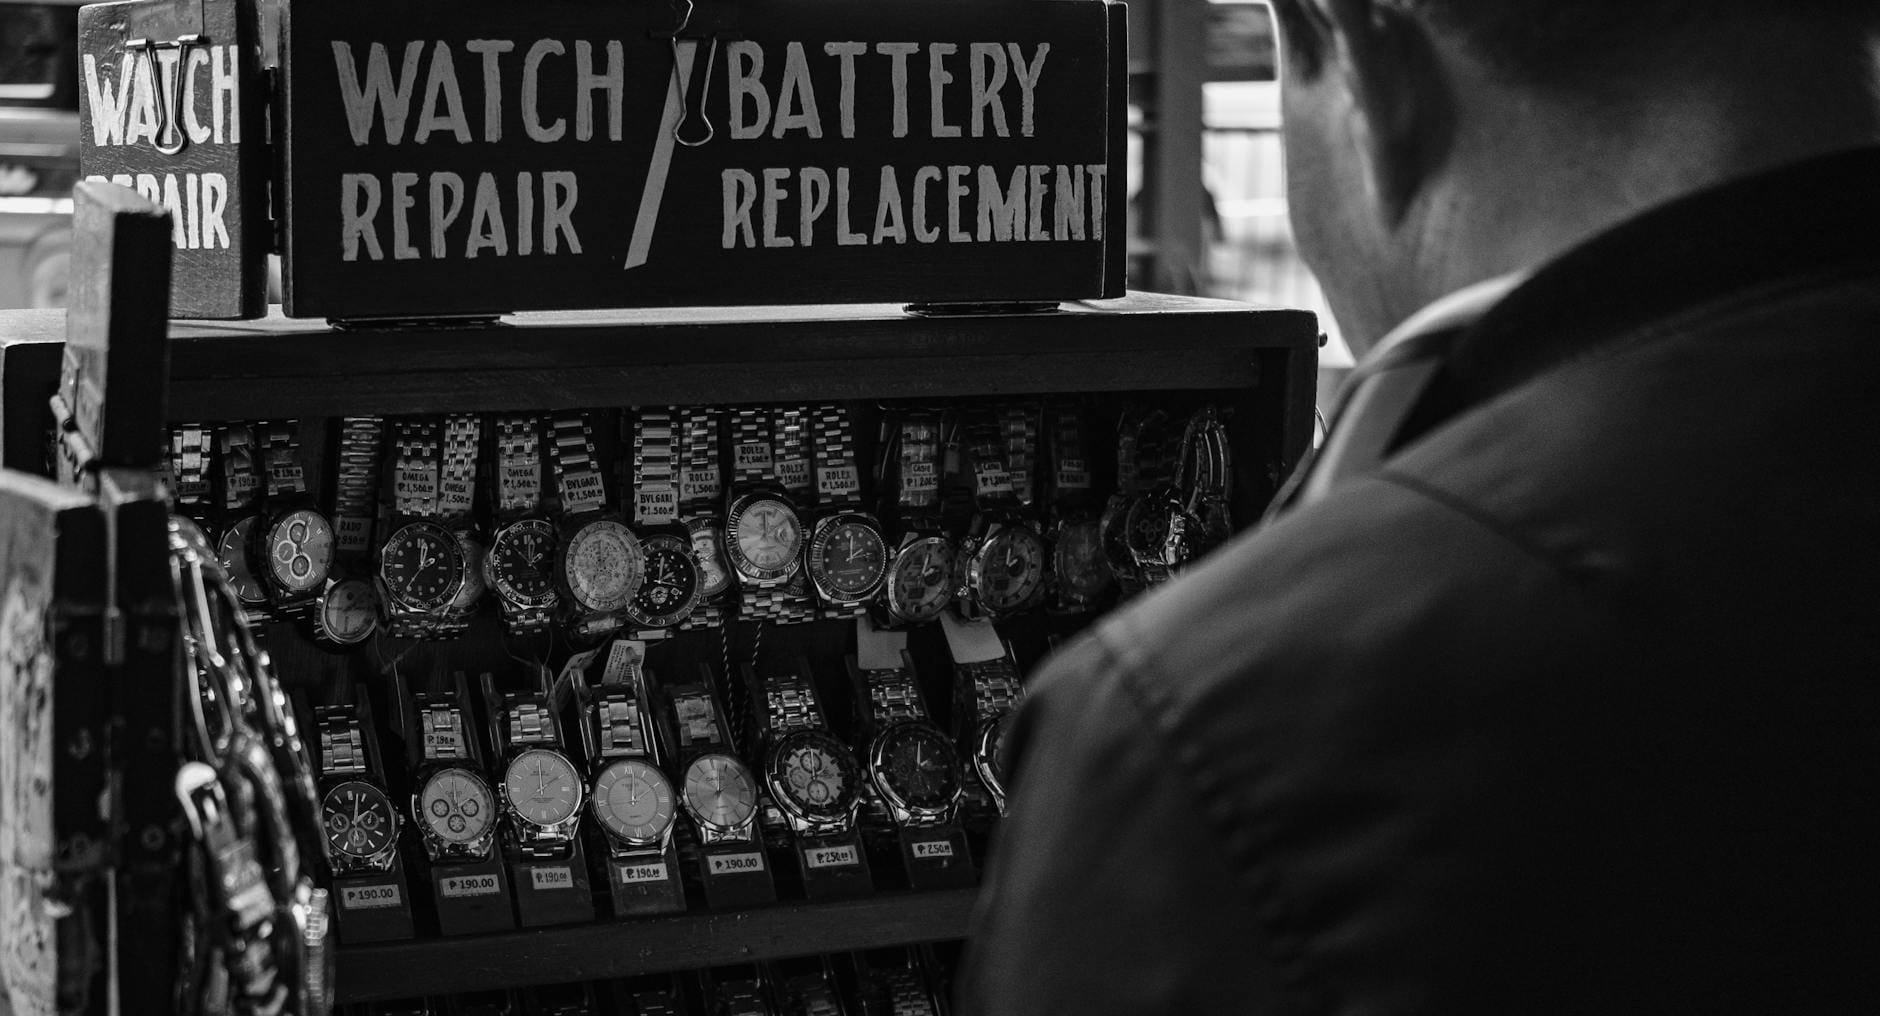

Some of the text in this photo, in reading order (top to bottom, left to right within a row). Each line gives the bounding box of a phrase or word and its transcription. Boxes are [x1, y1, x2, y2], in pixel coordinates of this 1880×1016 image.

[83, 45, 240, 146] WATCH
[331, 39, 624, 146] WATCH
[728, 40, 1050, 140] BATTERY
[85, 172, 230, 249] AIR
[722, 164, 1107, 249] REPLACEMENT
[342, 171, 583, 262] REPAIR
[507, 468, 534, 477] OMEGA
[780, 463, 804, 473] ROLEX
[402, 471, 430, 482] OMEGA
[689, 472, 714, 482] ROLEX
[825, 470, 851, 480] ROLEX
[445, 482, 466, 493] OMEGA
[565, 476, 599, 490] BVLGARI
[640, 494, 672, 504] BVLGARI
[725, 858, 758, 869] 190.00
[459, 878, 494, 889] 190.00
[358, 888, 393, 900] 190.00
